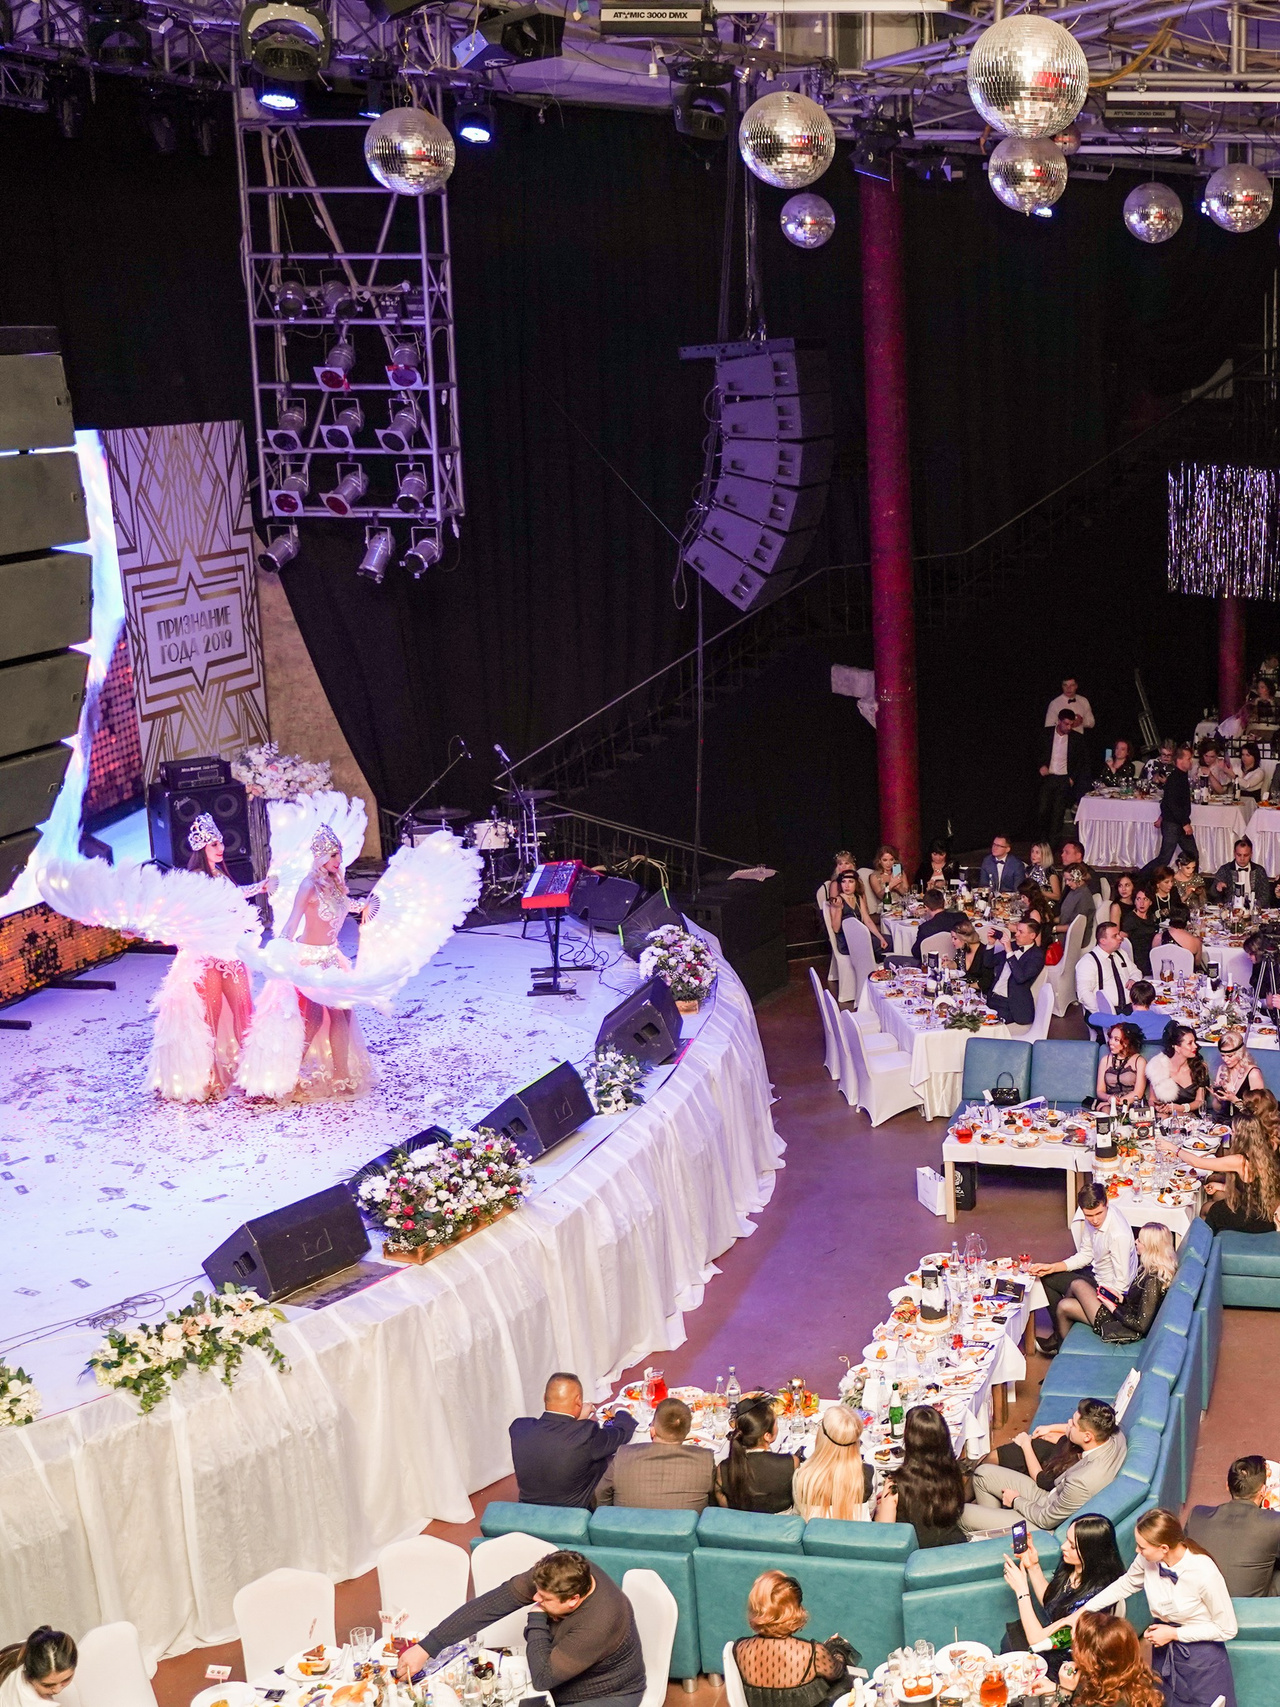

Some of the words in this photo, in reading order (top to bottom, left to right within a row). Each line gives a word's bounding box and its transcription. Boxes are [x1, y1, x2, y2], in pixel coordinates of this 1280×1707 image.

[157, 605, 231, 641] ПРИЗНАНИЕ
[161, 638, 200, 665] ГОДА
[203, 629, 233, 654] 2019
